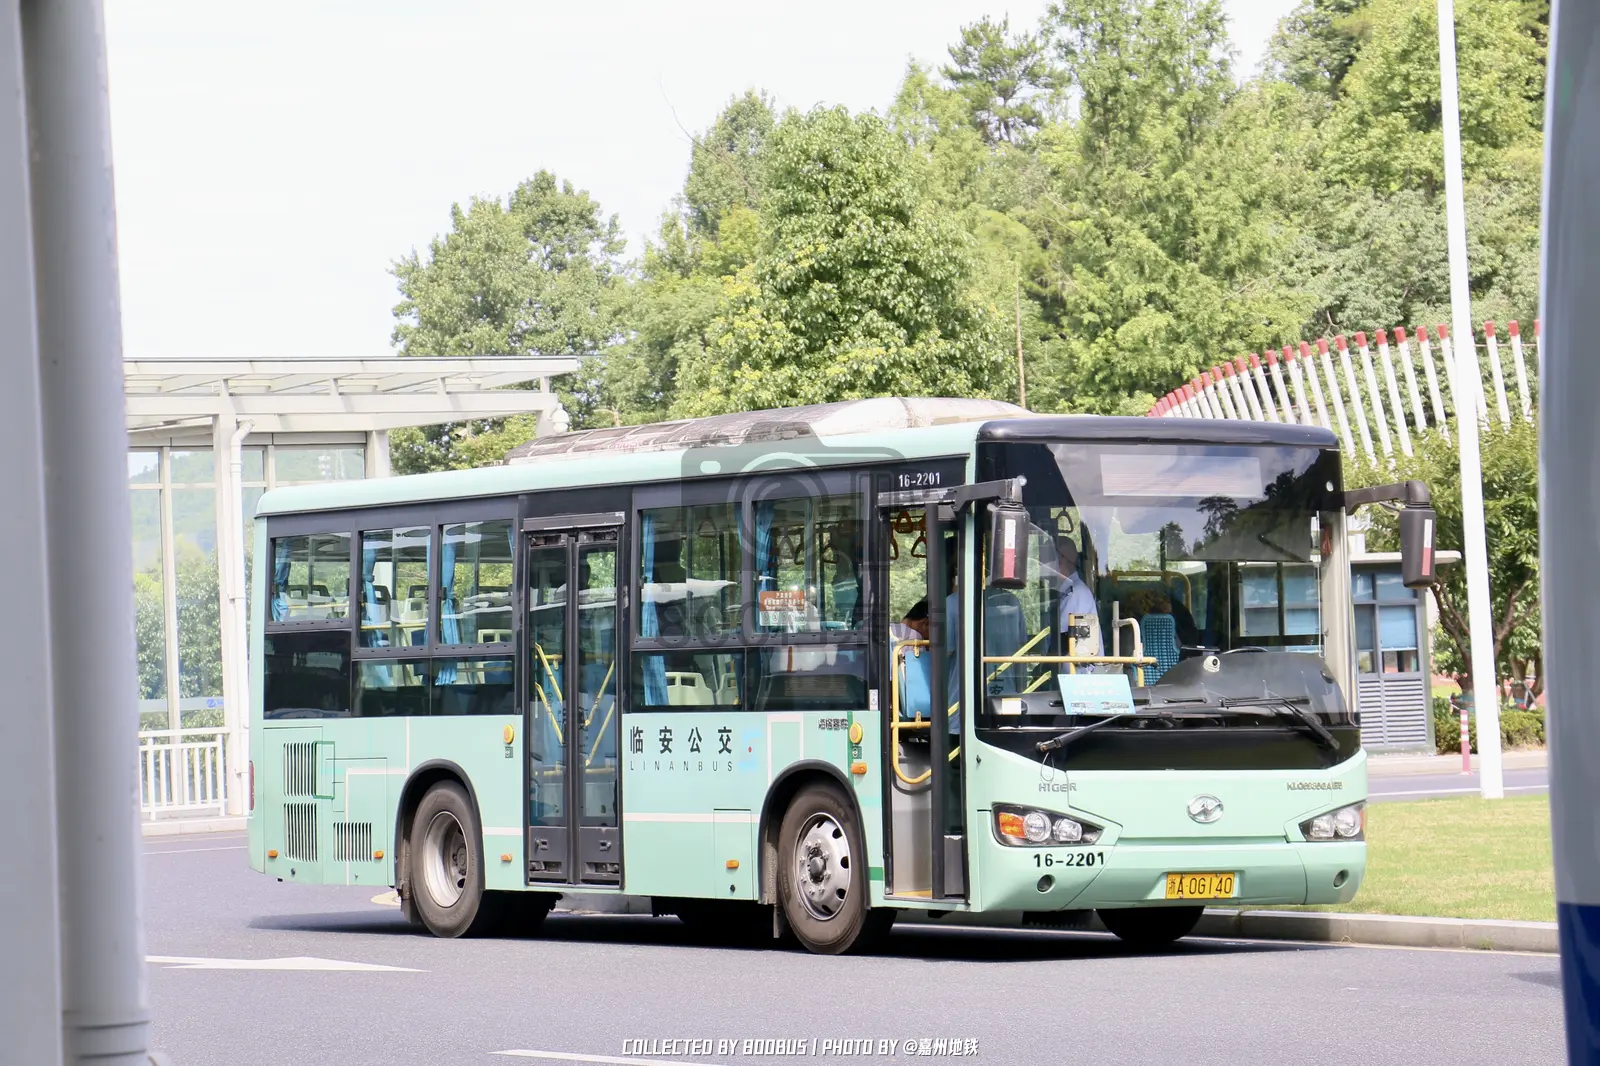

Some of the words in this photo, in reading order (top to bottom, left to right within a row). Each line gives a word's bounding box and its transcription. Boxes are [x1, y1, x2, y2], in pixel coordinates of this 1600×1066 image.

[898, 471, 940, 488] 16-2201
[629, 725, 733, 755] 临安公交
[629, 760, 733, 772] LINANBUS
[1038, 782, 1078, 793] HIGER
[1033, 851, 1105, 868] 16-2201
